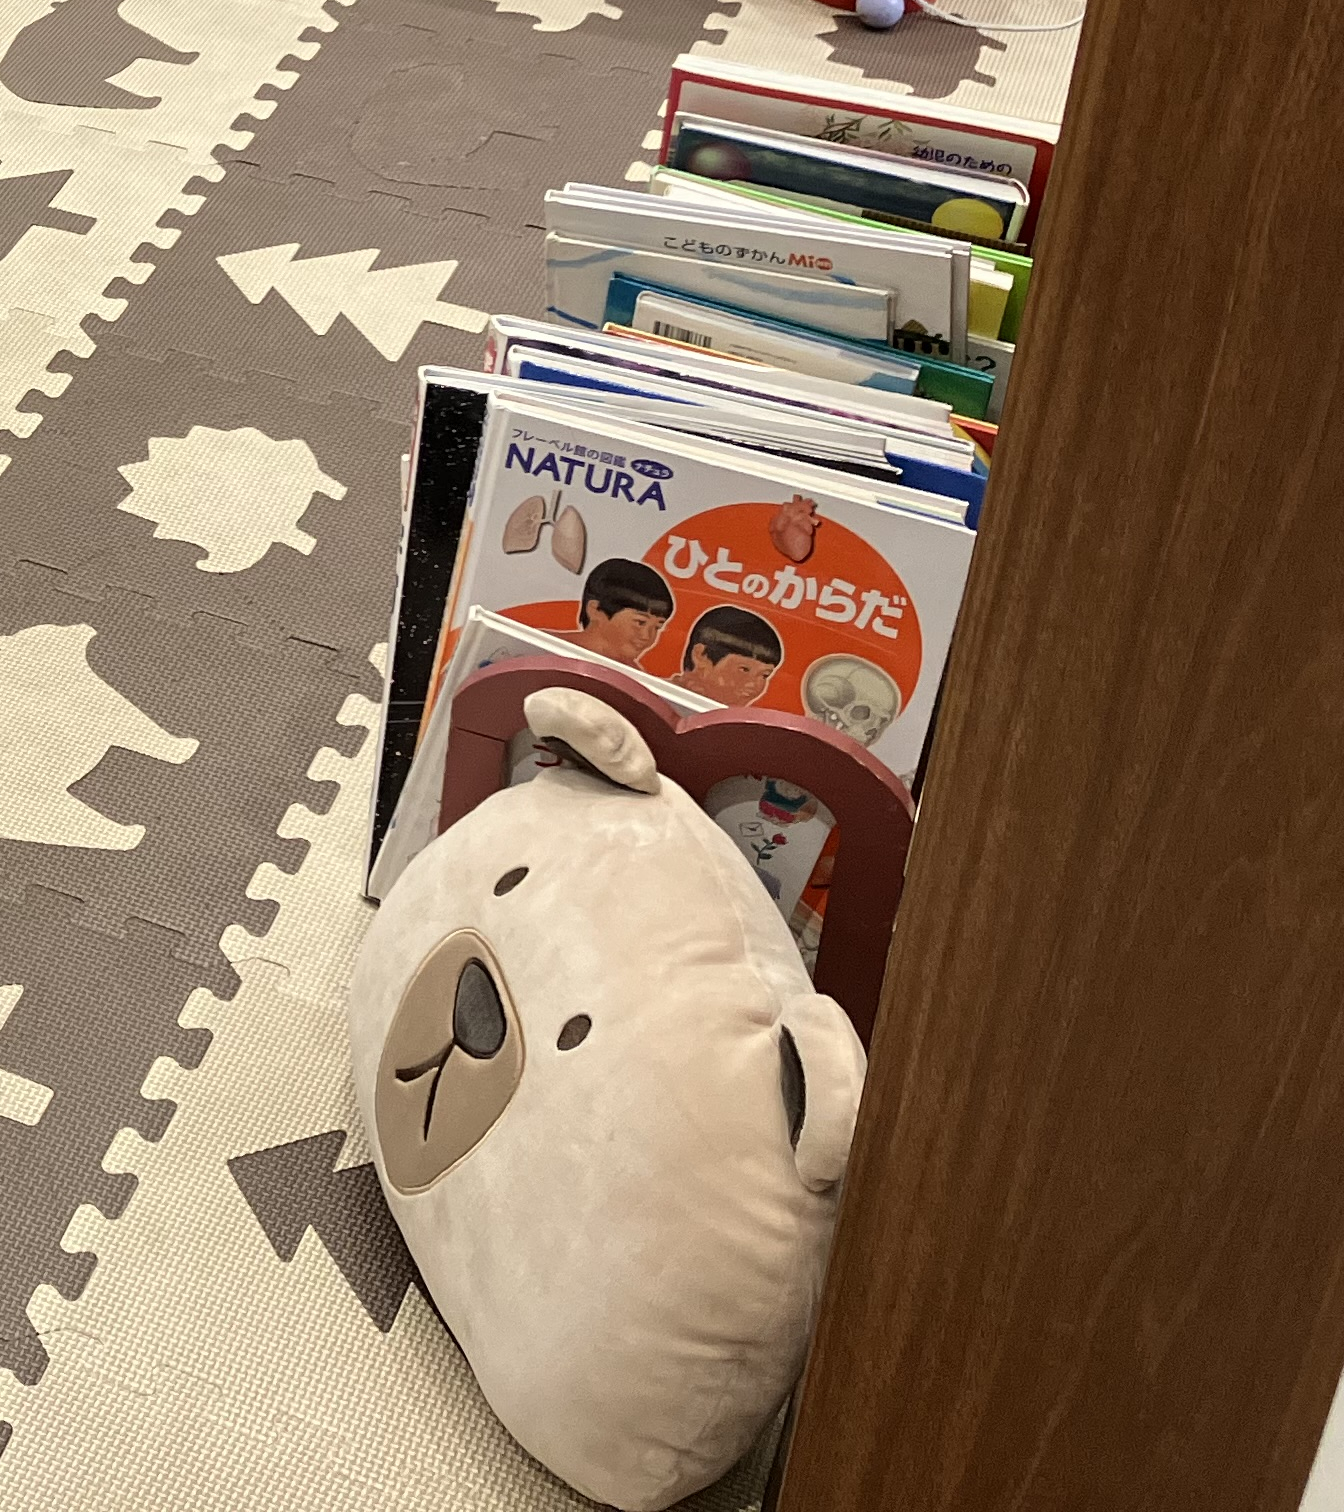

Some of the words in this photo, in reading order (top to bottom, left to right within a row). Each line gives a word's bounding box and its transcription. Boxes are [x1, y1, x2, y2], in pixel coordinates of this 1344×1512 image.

[913, 145, 1012, 175] 幼児のための
[511, 428, 626, 469] フレーベル館の図鑑
[504, 442, 666, 512] NATURA
[664, 534, 908, 640] ひとのからだ
